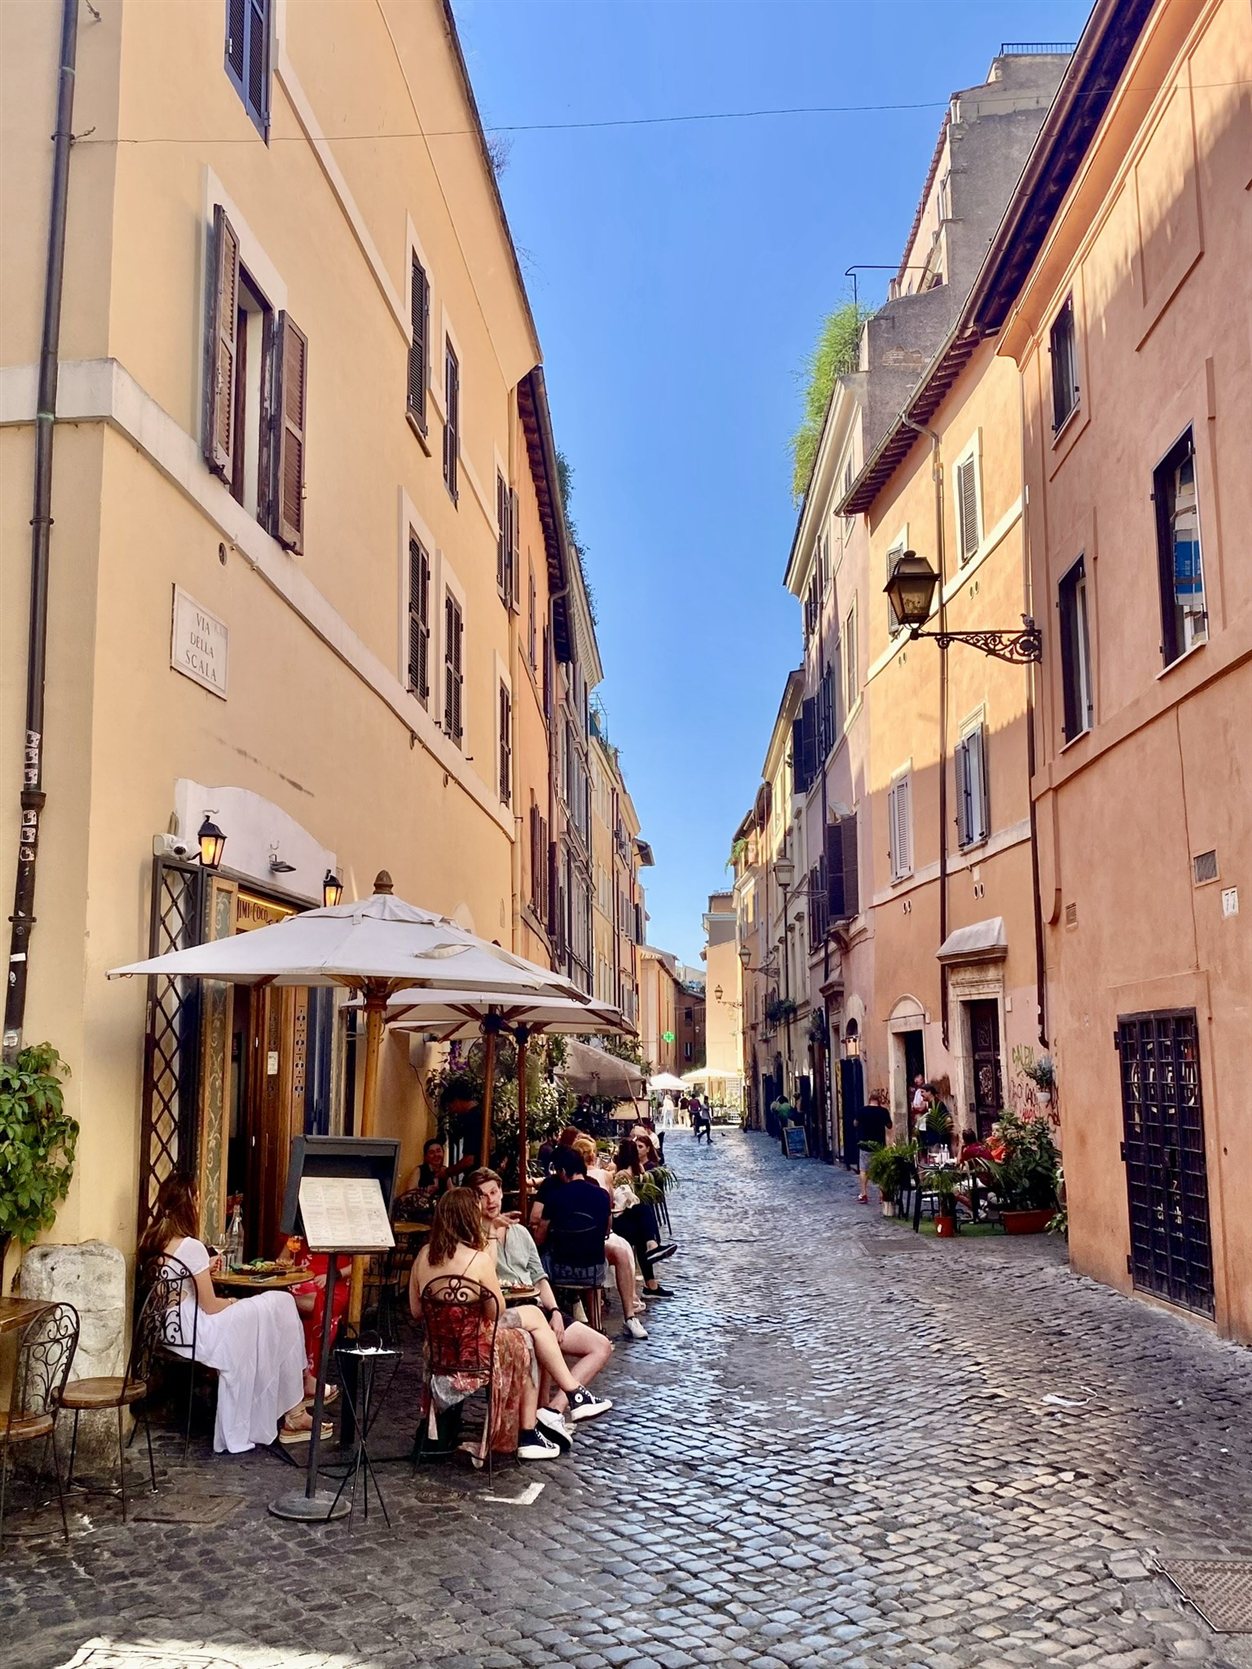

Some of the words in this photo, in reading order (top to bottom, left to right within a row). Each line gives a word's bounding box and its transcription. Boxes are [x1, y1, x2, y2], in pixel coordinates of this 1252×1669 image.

[196, 612, 210, 635] VIA
[190, 632, 214, 659] DELLA
[185, 650, 217, 682] SCALA
